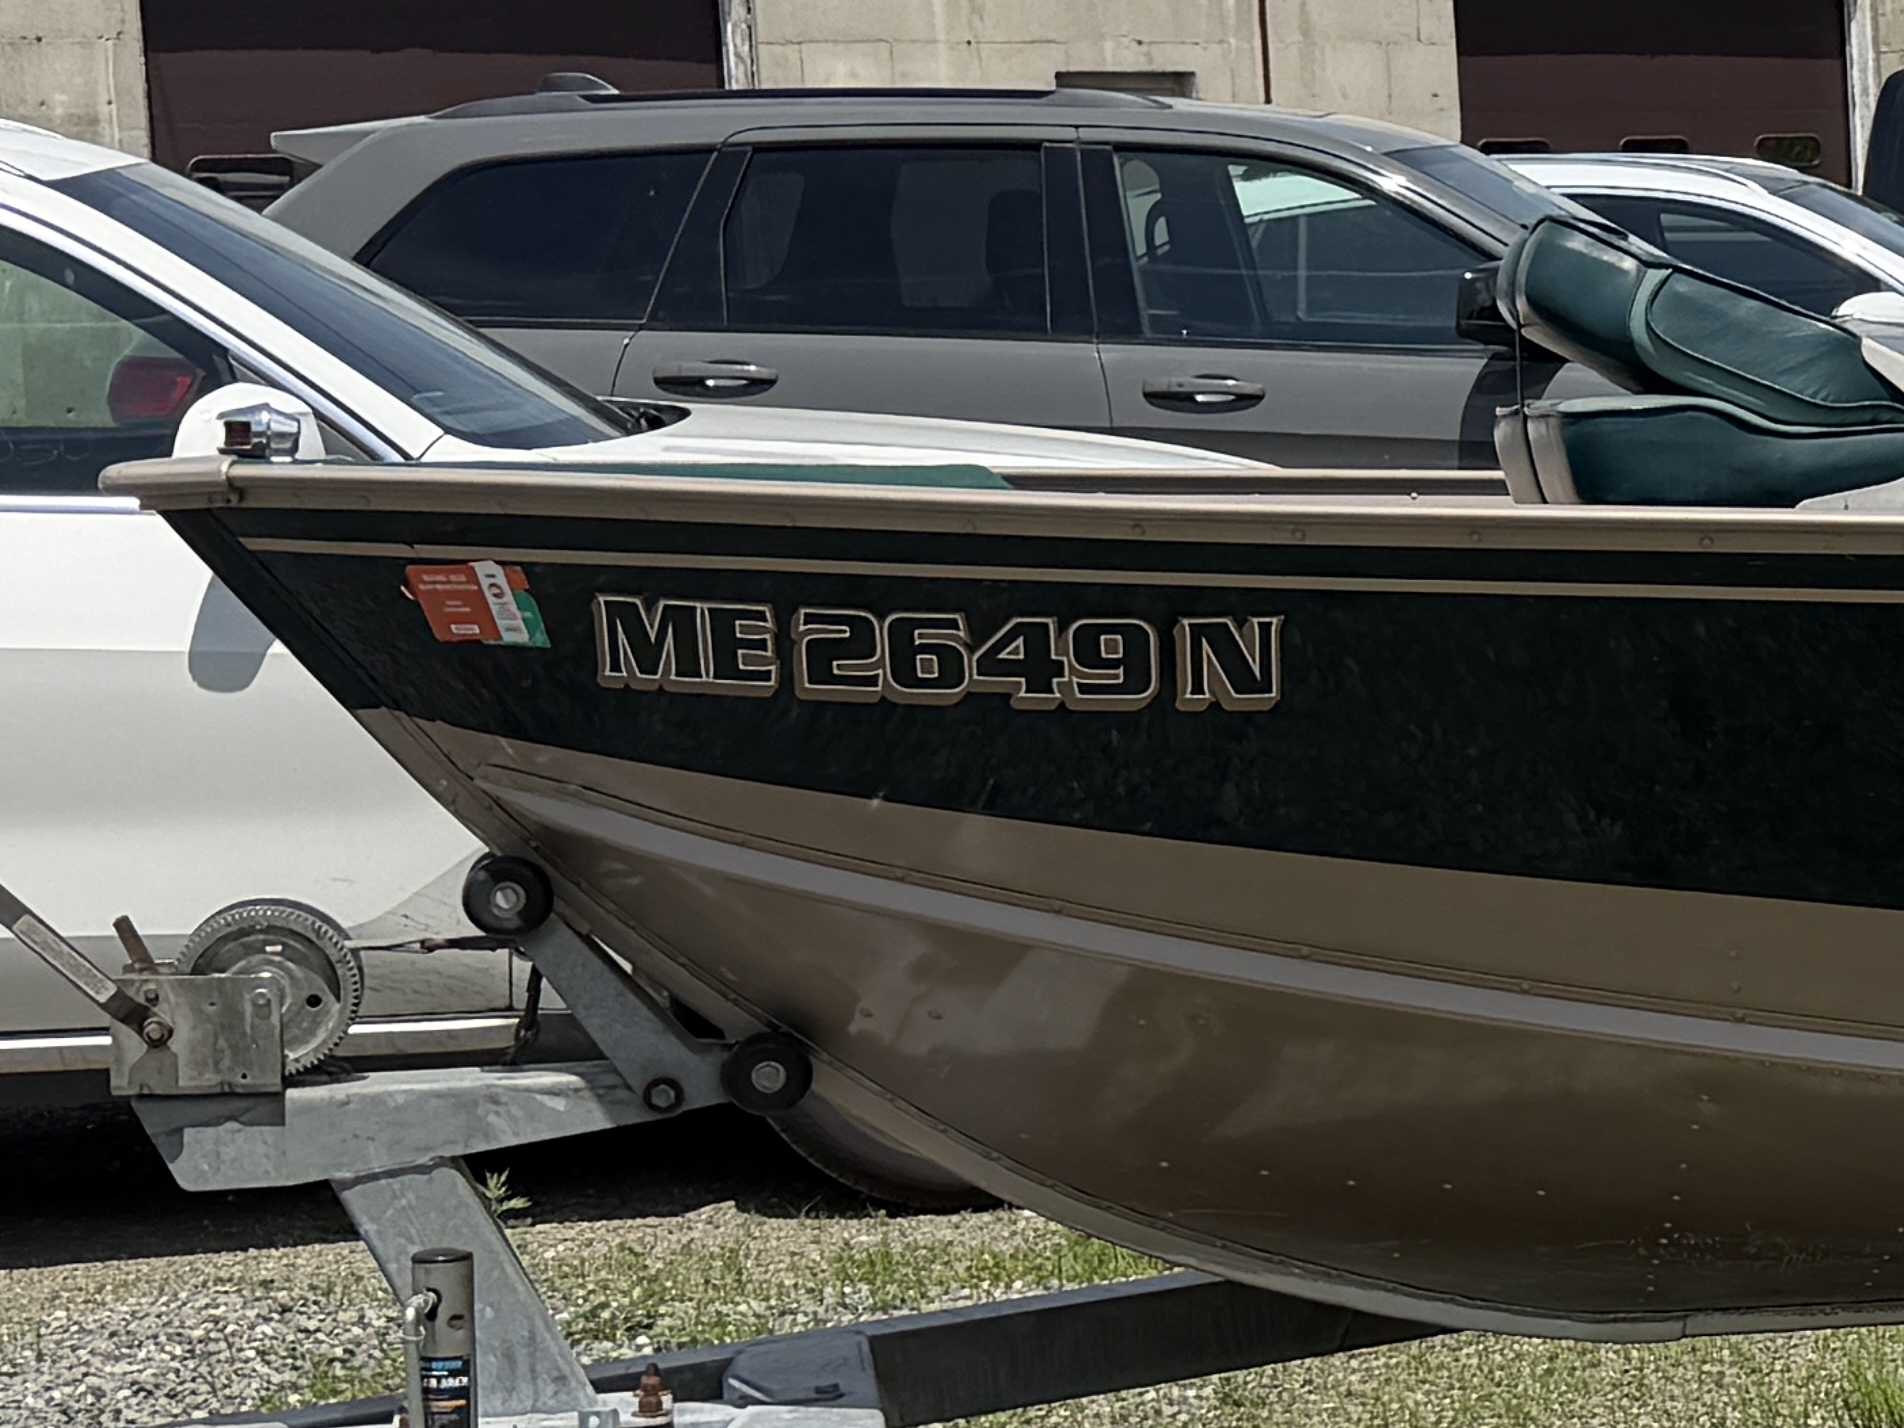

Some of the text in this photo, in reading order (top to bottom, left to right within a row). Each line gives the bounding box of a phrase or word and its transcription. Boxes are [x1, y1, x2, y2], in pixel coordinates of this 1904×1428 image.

[596, 594, 1285, 712] ME 2649 N
